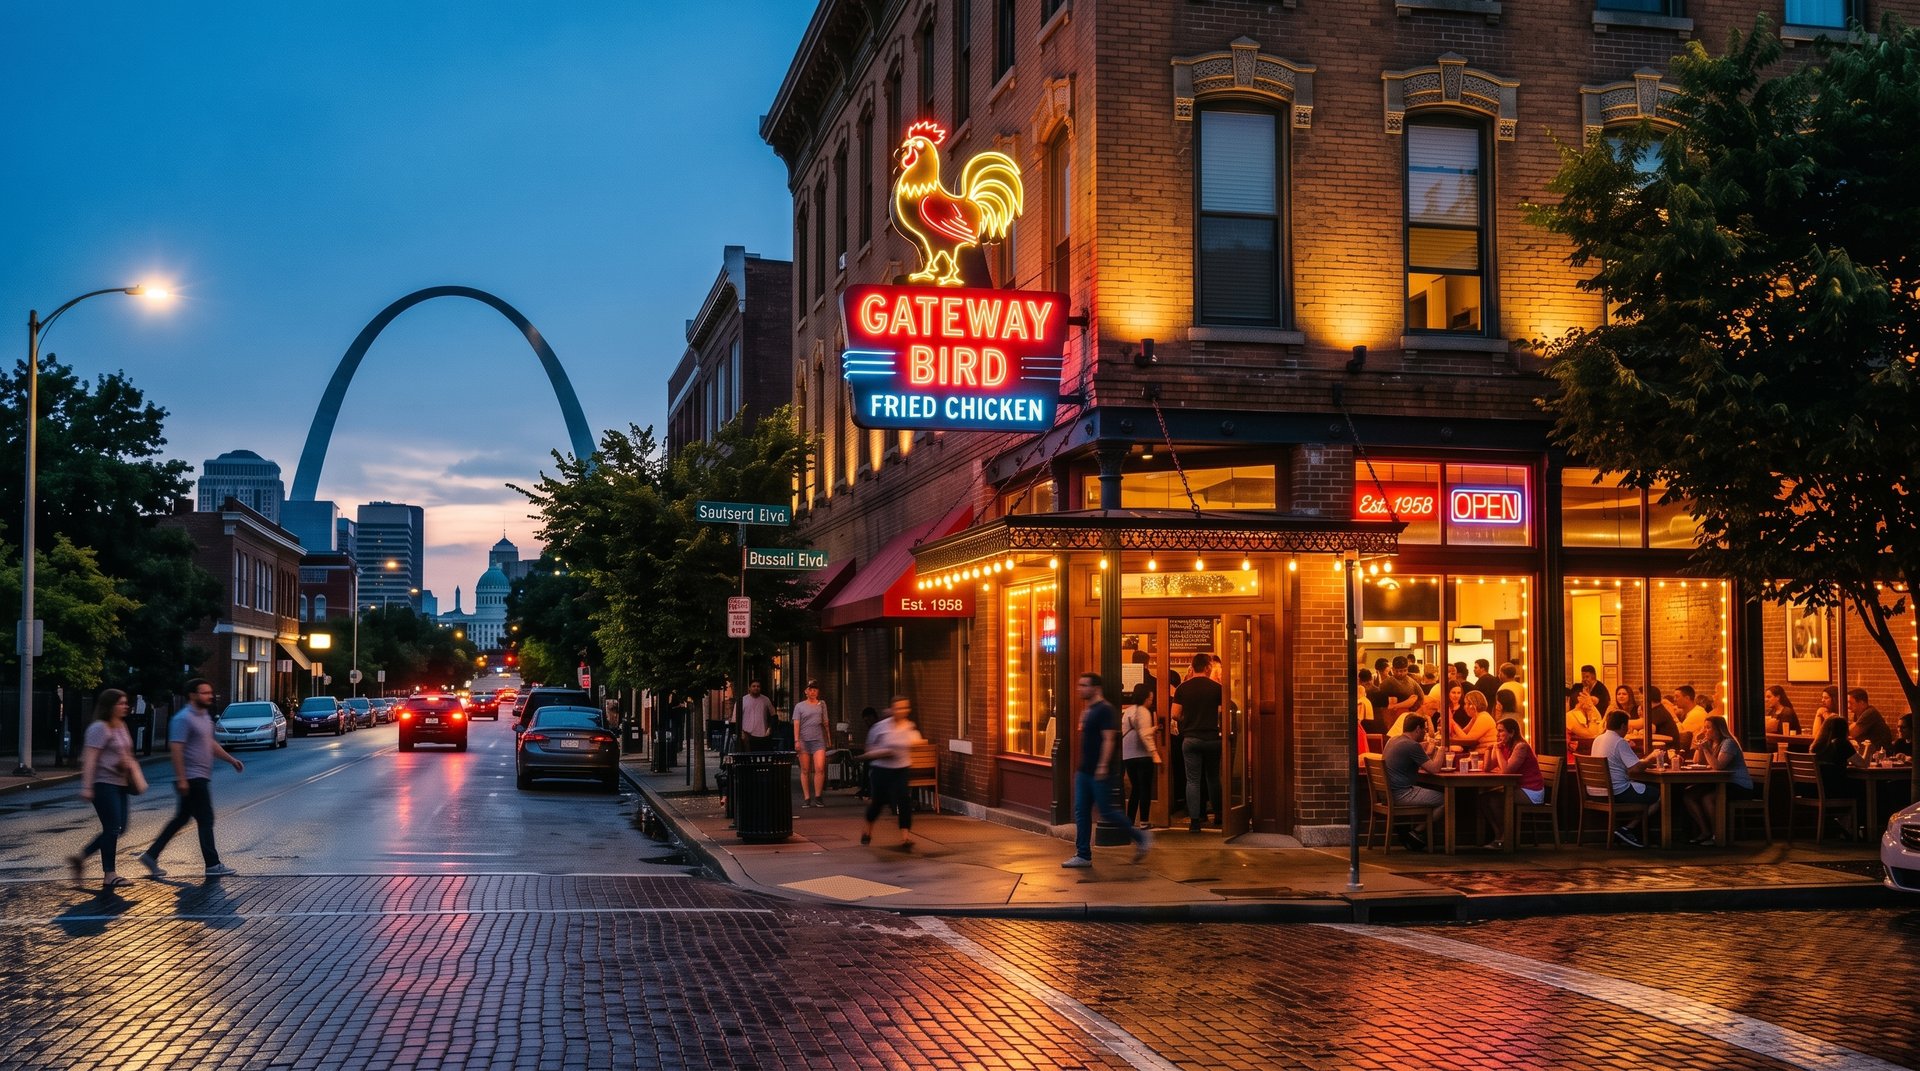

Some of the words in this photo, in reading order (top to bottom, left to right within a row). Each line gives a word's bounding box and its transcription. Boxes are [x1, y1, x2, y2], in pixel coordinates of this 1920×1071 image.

[861, 294, 1053, 341] GATEWAY
[910, 345, 1007, 387] BIRD
[870, 394, 937, 418] FRIED
[945, 396, 1043, 422] CHICKEN
[1394, 496, 1434, 514] 1958
[1454, 492, 1518, 520] OPEN
[901, 598, 927, 611] Est.
[930, 598, 963, 611] 1958
